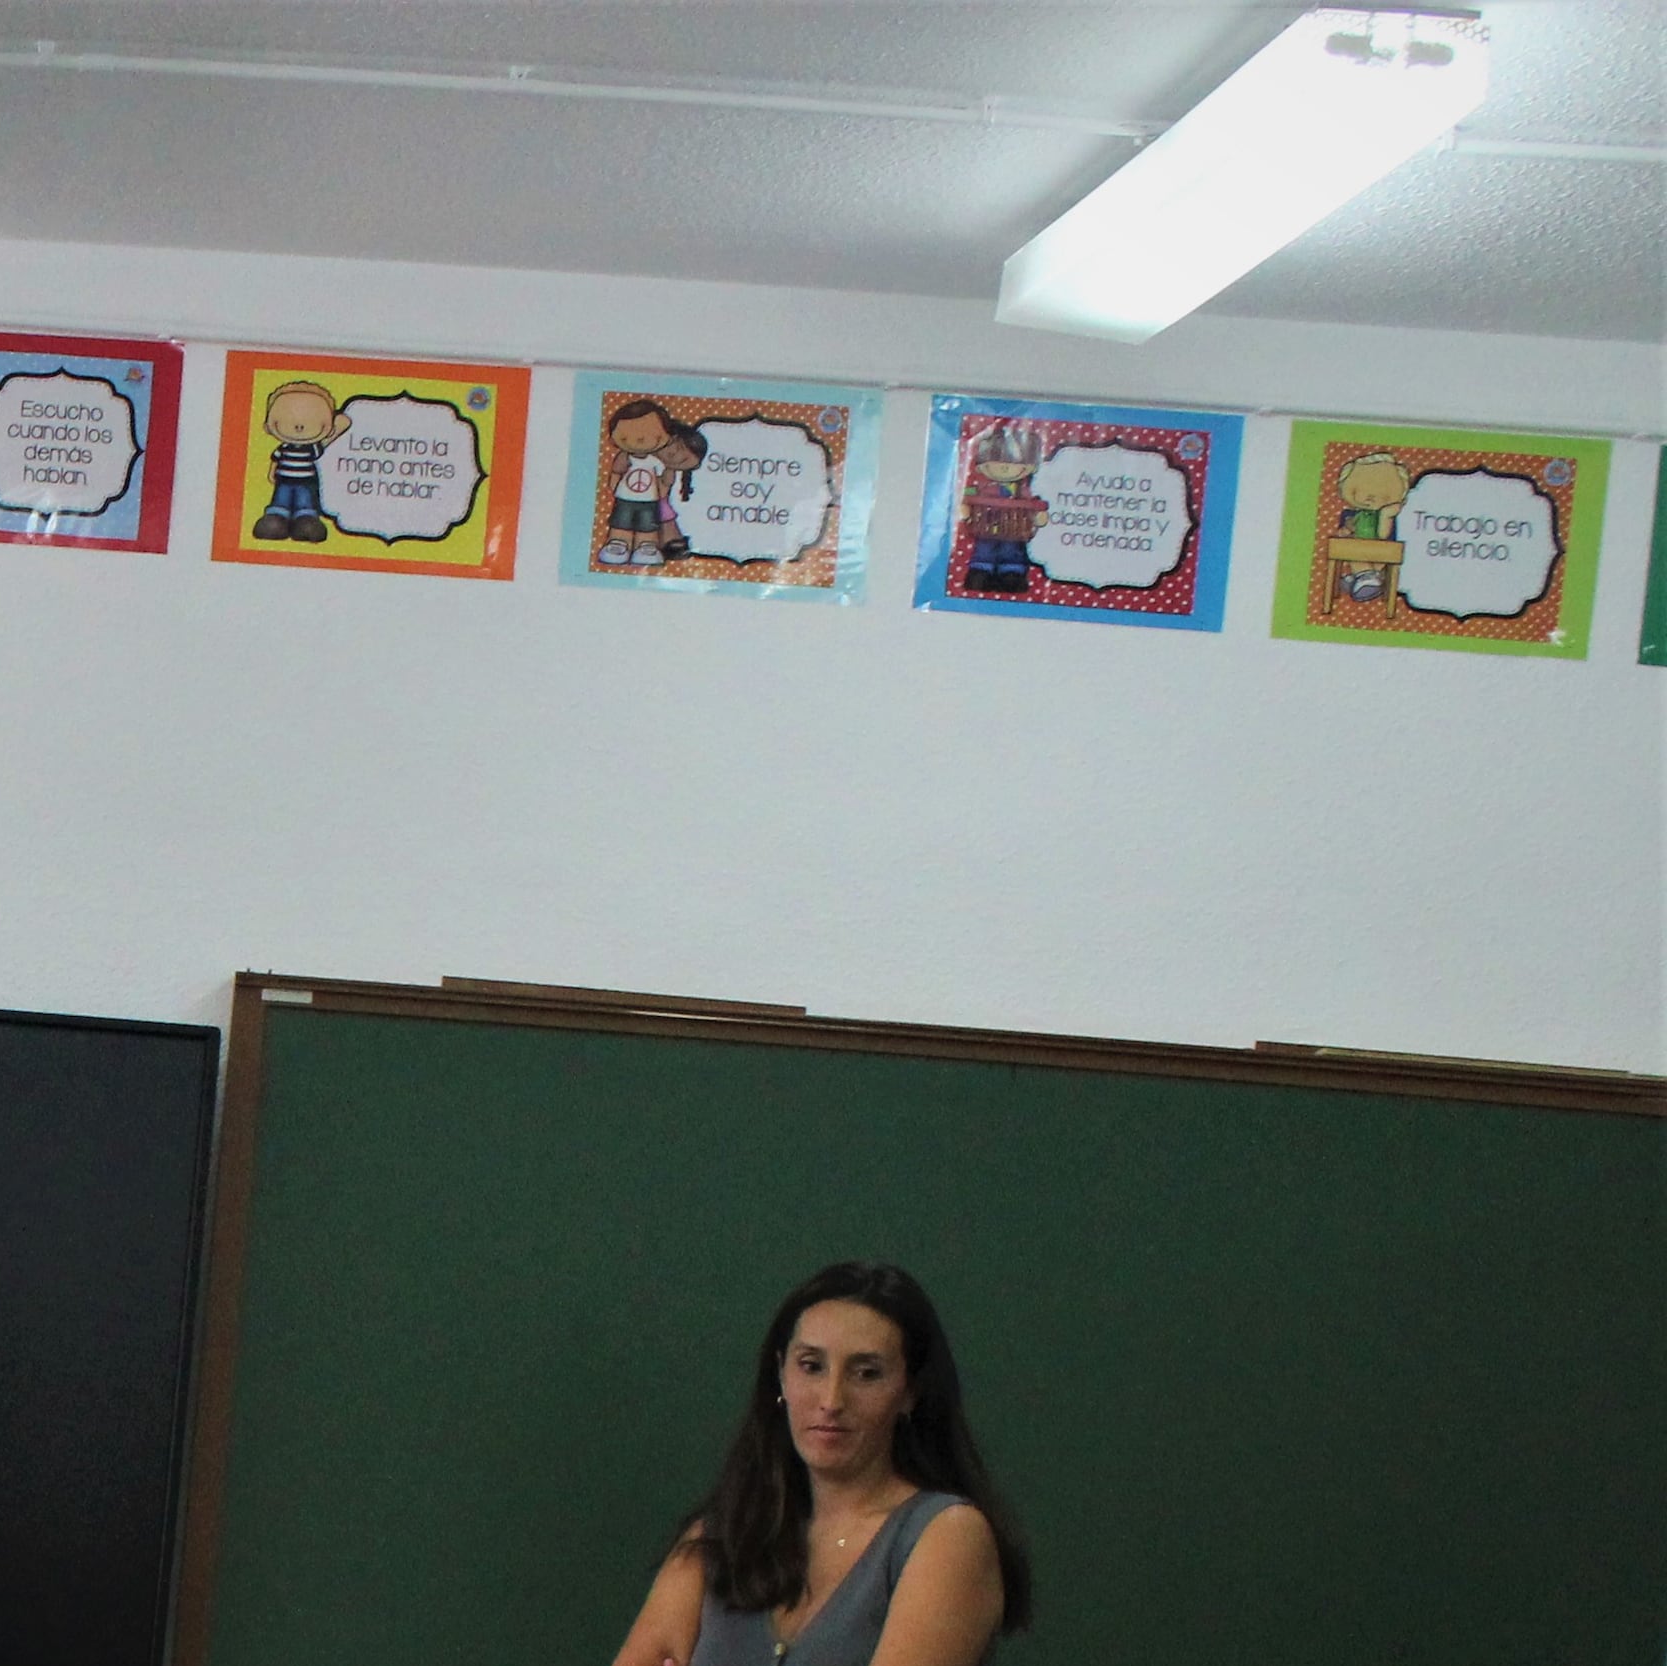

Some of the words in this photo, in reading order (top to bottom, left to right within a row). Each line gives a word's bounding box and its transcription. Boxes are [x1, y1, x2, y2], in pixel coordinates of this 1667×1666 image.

[20, 399, 104, 423] Escucho
[7, 422, 81, 443] cuando
[84, 426, 113, 445] los
[348, 433, 429, 456] Levanto
[431, 436, 449, 457] la
[23, 443, 94, 465] demás
[706, 451, 802, 480] Siempre
[337, 456, 395, 476] mano
[399, 459, 456, 480] antes
[346, 476, 374, 495] de
[730, 481, 775, 504] soy
[1075, 471, 1136, 493] Ayudo
[1139, 477, 1153, 493] a
[1056, 491, 1149, 512] mantener
[1150, 495, 1167, 514] la
[1048, 508, 1099, 528] clase
[1101, 514, 1151, 534] limpia
[1154, 519, 1170, 537] y
[1413, 509, 1498, 541] Trabajo
[1503, 518, 1534, 540] en
